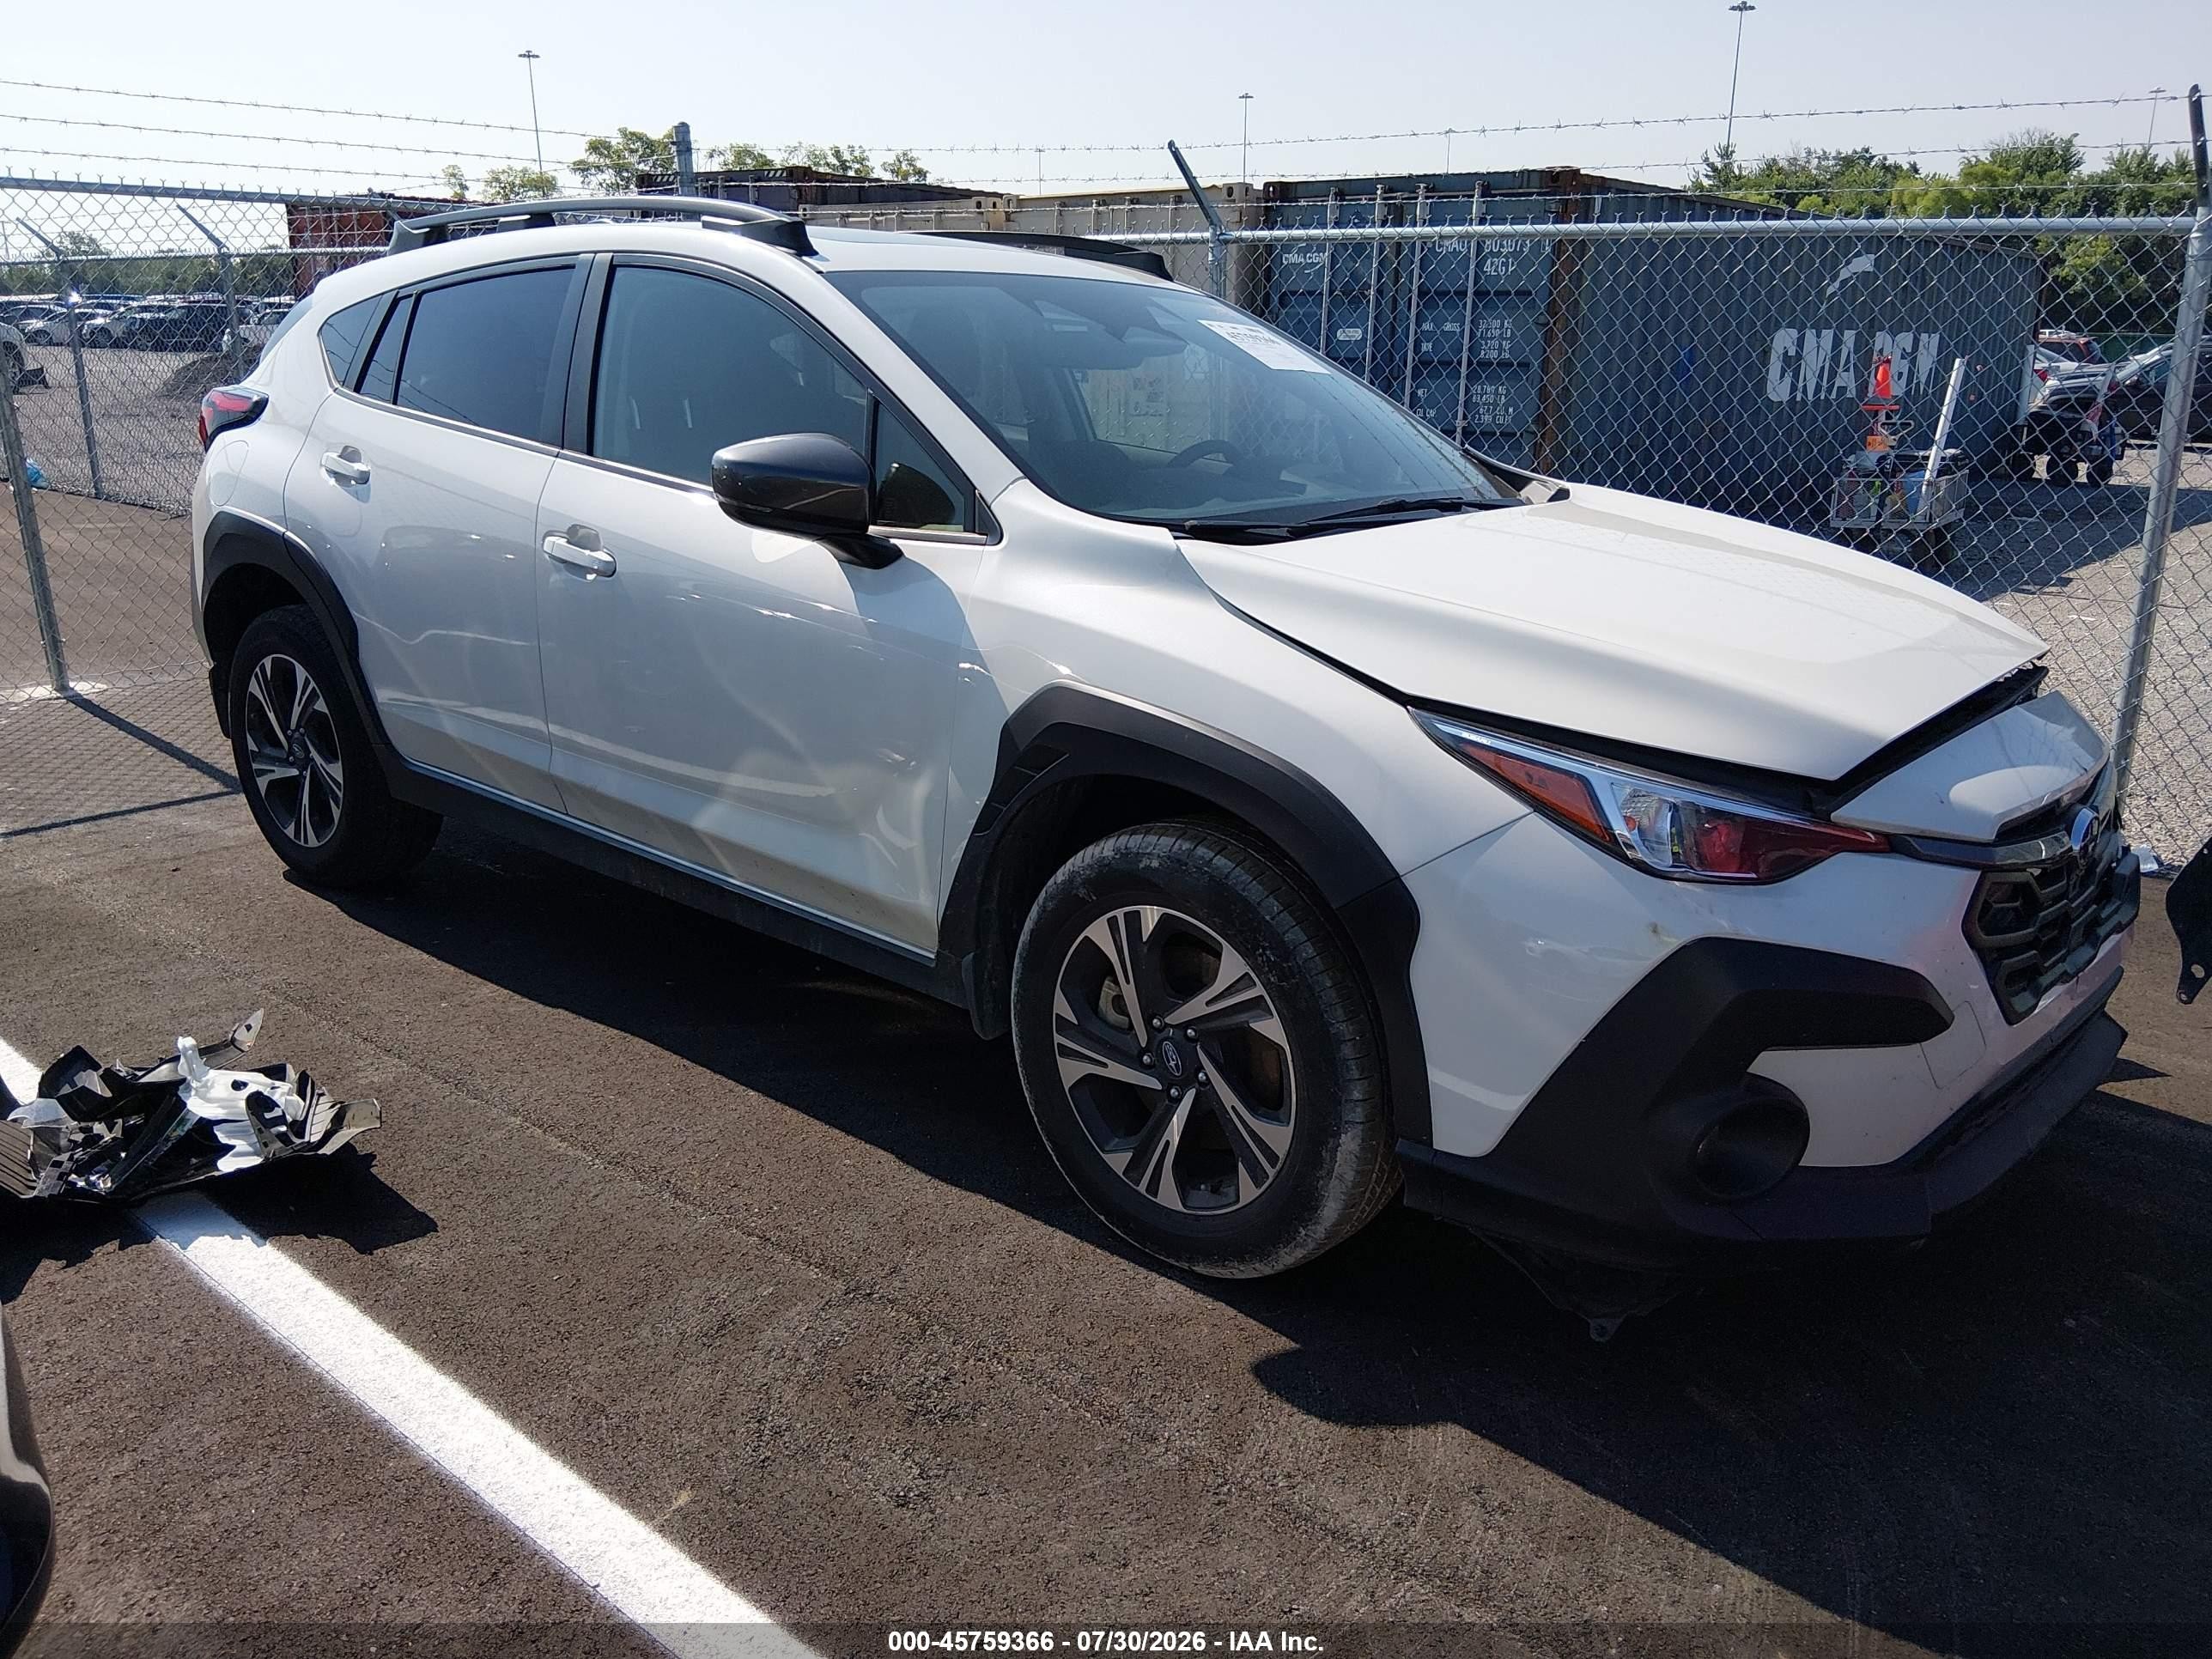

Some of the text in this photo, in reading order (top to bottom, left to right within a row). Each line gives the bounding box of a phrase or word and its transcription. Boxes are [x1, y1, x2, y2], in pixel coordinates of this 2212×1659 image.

[1282, 253, 1304, 264] CMA
[1483, 258, 1512, 276] 42G1
[1766, 328, 1856, 402] CMA
[1498, 386, 1506, 394] KG
